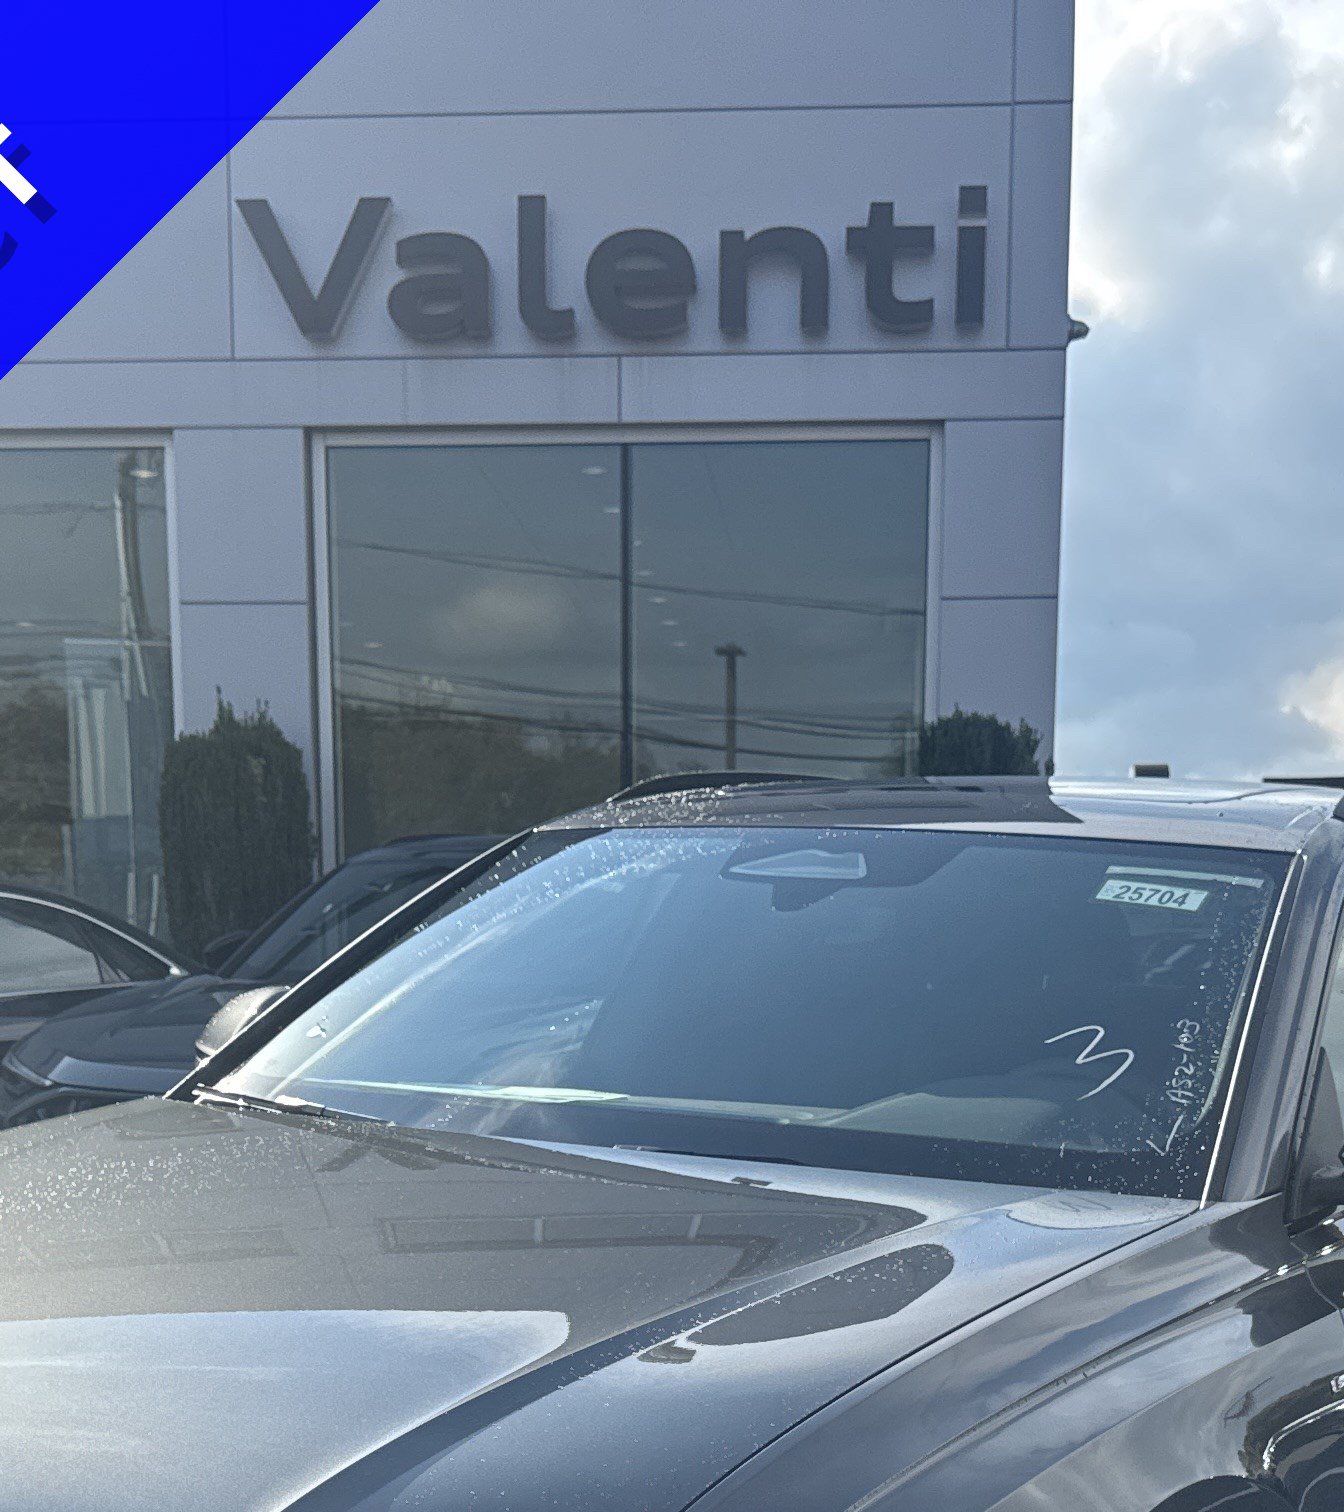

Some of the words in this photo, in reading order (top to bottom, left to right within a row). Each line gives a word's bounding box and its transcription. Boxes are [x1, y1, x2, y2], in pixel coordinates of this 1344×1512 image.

[235, 185, 989, 341] Valenti
[1111, 884, 1191, 907] 25704
[1044, 1025, 1134, 1101] 3
